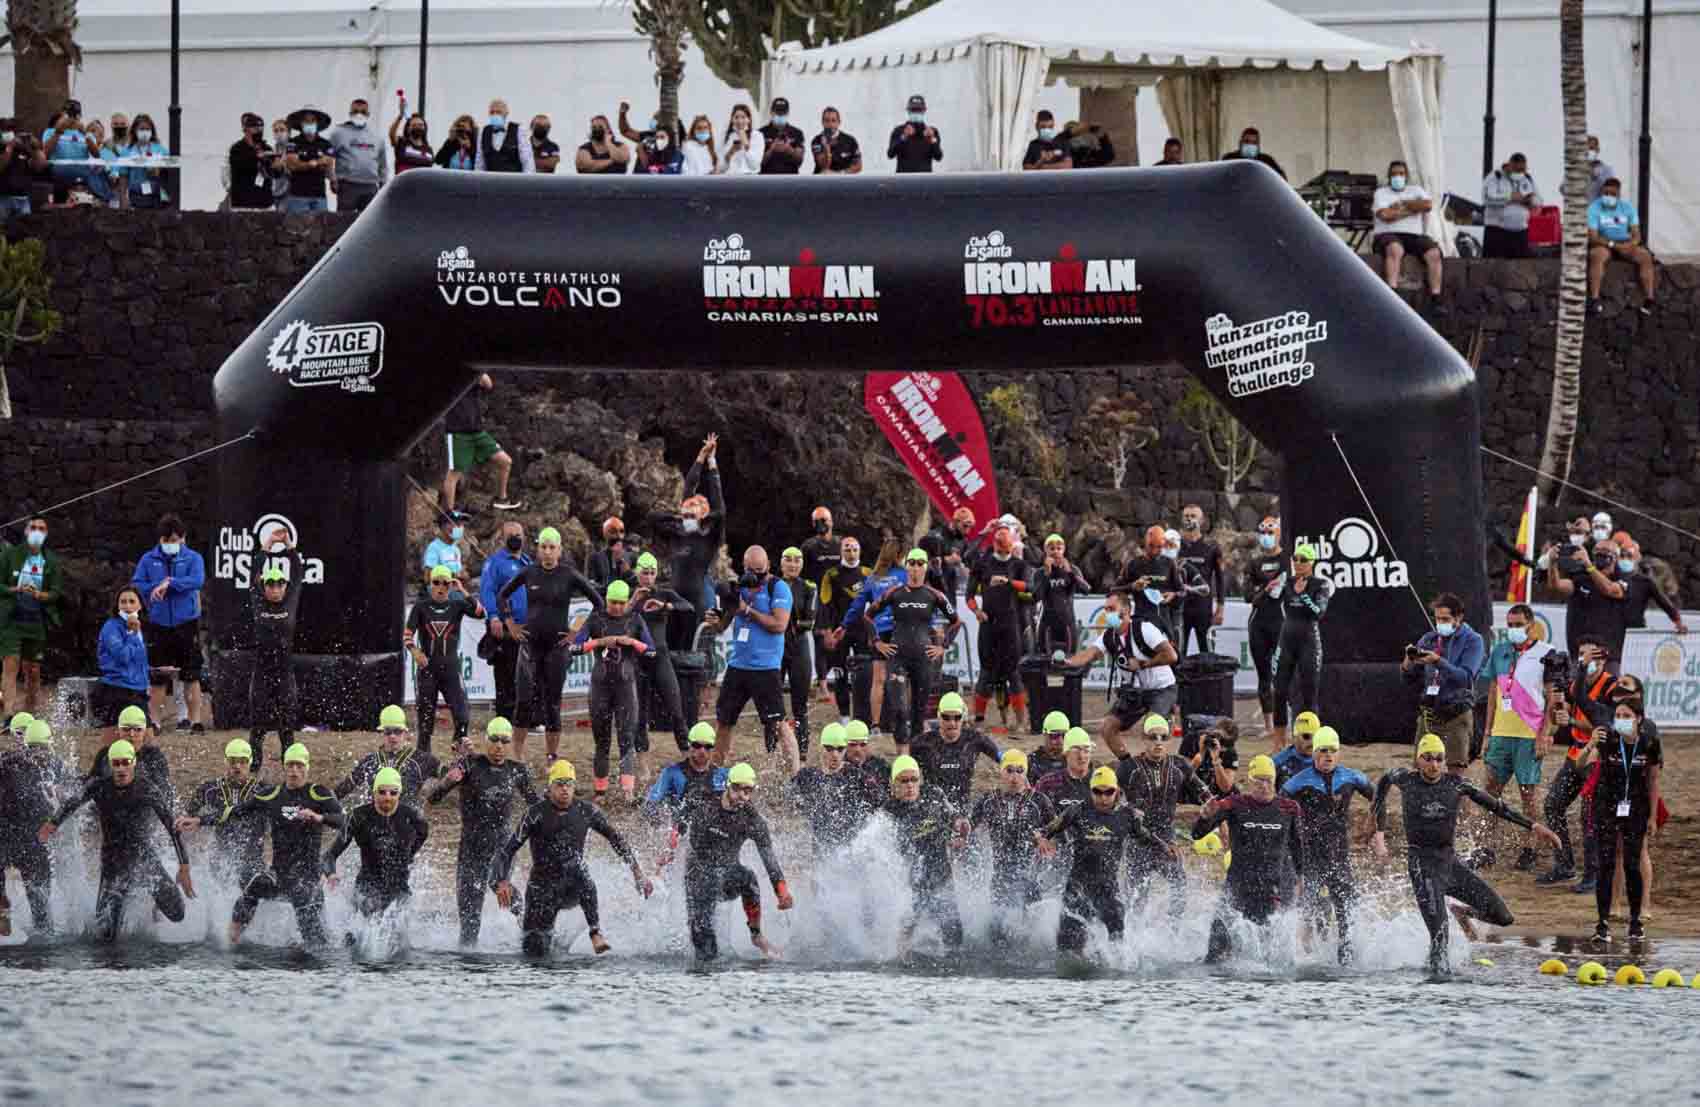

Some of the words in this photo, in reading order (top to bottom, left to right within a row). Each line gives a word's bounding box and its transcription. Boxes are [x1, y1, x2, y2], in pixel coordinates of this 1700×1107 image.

[441, 250, 456, 259] Club
[708, 239, 727, 249] Club
[969, 236, 989, 247] Club
[437, 271, 526, 284] LANZAROTE
[534, 272, 621, 285] TRIATHLON
[703, 265, 874, 298] IRONMAN
[963, 259, 1137, 294] IRONMAN
[437, 285, 622, 308] VOLCANO
[964, 297, 1037, 327] 70.3
[276, 326, 301, 364] 4
[304, 330, 371, 355] STAGE
[1207, 323, 1325, 366] International
[1210, 313, 1307, 348] Lanzarote
[300, 369, 321, 379] RACE
[322, 365, 370, 377] LANZAROTE
[302, 357, 347, 371] MOUNTAIN
[348, 355, 370, 366] BIKE
[1228, 347, 1303, 377] Running
[1230, 364, 1312, 395] Challenge
[890, 375, 986, 497] IRONMAN
[220, 527, 254, 552] Club
